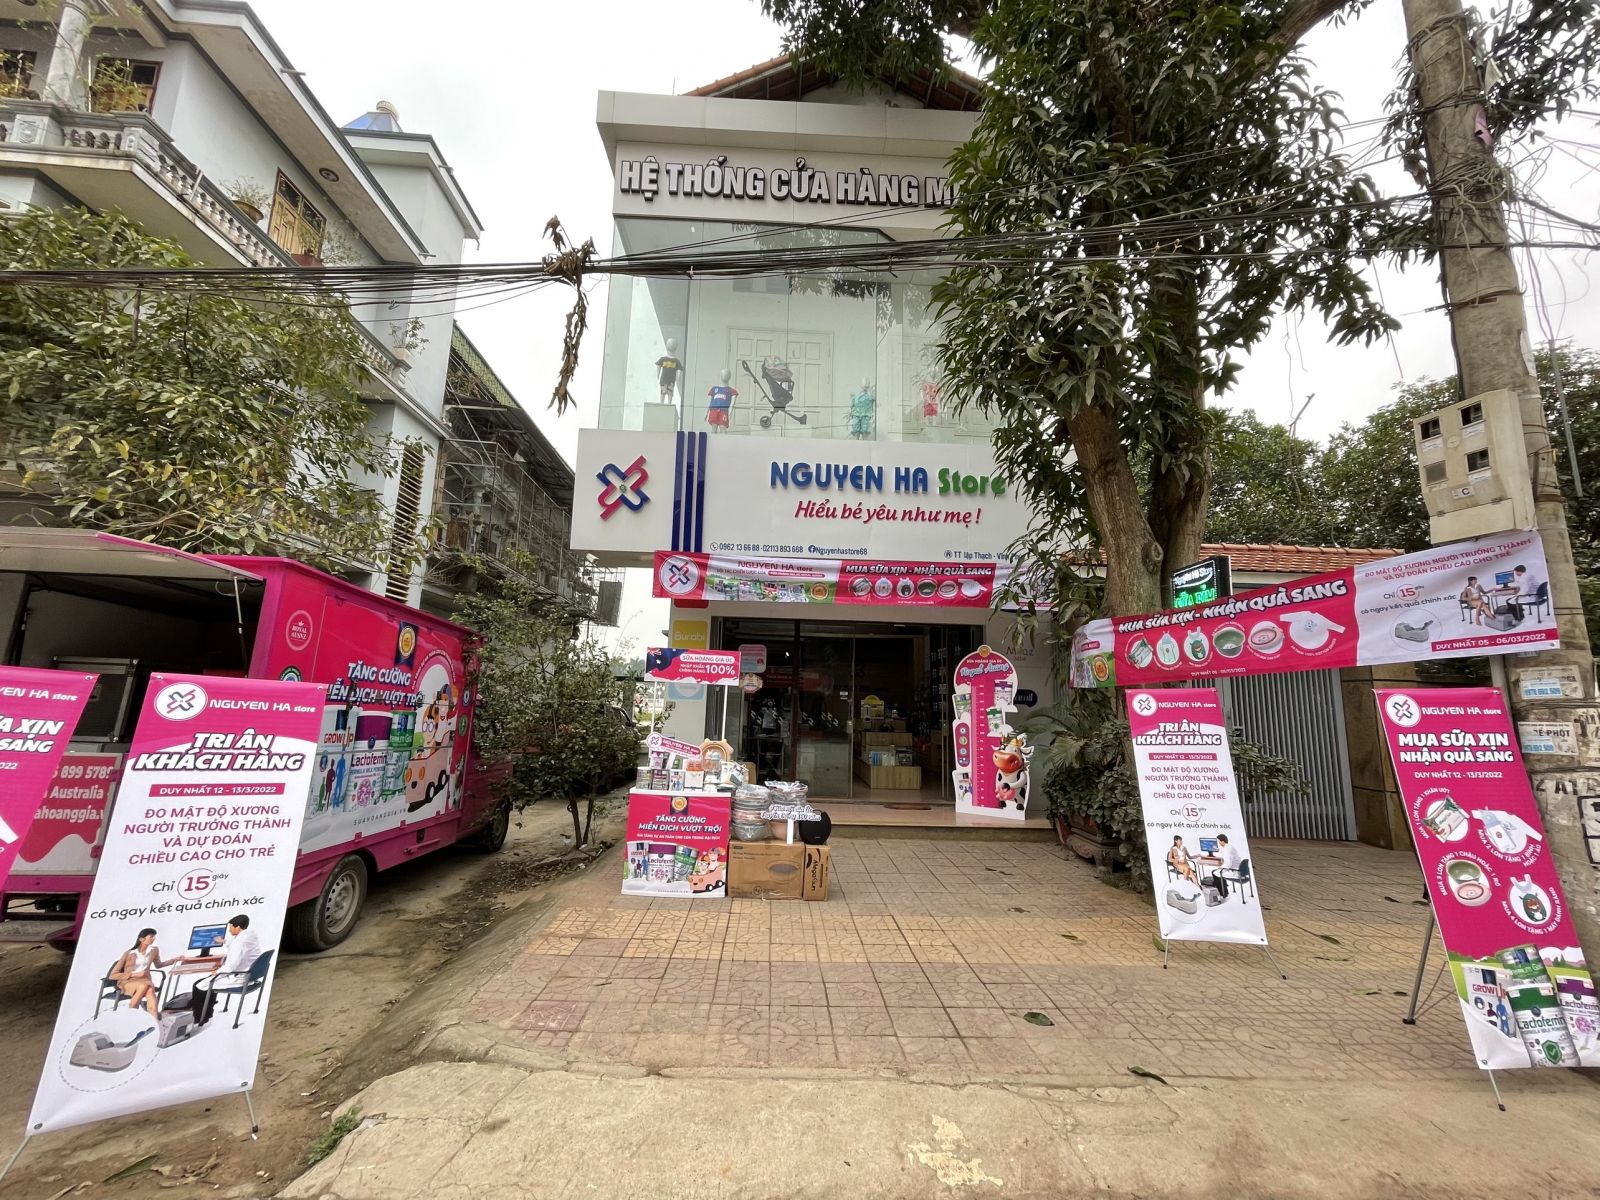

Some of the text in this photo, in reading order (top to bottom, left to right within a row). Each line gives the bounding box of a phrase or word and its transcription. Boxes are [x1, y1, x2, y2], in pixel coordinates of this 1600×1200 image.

[620, 155, 960, 208] HỆ THỐNG CỬA HÀNG M
[770, 461, 1006, 497] NGUYEN HA Store
[794, 499, 972, 528] Hiểu bé yêu như mẹ
[719, 542, 735, 551] 0962
[779, 545, 791, 553] 893
[845, 565, 868, 573] MUA
[869, 564, 889, 574] SỮA
[914, 566, 943, 578] NHẬN
[944, 564, 965, 576] QUÀ
[965, 567, 992, 575] SANG
[1399, 587, 1416, 597] 15
[1118, 621, 1145, 634] MUA
[1145, 614, 1170, 628] SỮA
[1203, 595, 1249, 618] NHẬN
[1249, 586, 1291, 611] QUÀ
[1291, 579, 1347, 603] SANG
[1453, 639, 1477, 649] NHẤT
[1496, 633, 1546, 645] 06/03/2022
[347, 660, 377, 680] TĂNG
[378, 665, 412, 686] CƯỜNG
[705, 664, 735, 675] 100%
[29, 689, 78, 701] HA store
[328, 677, 349, 701] IỄN
[209, 699, 270, 711] NGUYEN
[272, 703, 291, 712] HA
[1421, 706, 1465, 715] NGUYEN
[1467, 707, 1481, 715] HA
[1158, 719, 1200, 733] TRI ÂN
[0, 738, 54, 753] SANG
[193, 728, 275, 750] TRI ÂN
[1136, 732, 1222, 746] KHÁCH HÀNG
[1398, 732, 1439, 747] MUA
[1440, 728, 1478, 747] SỮA
[1478, 732, 1510, 751] XỊN
[134, 748, 305, 771] KHÁCH HÀNG
[1399, 747, 1514, 766] NHẬN QUÀ SANG
[61, 766, 83, 779] 899
[1193, 766, 1220, 774] XƯƠNG
[1414, 771, 1430, 779] DUY
[1431, 769, 1452, 779] NHẤT
[1467, 771, 1503, 779] 13/3/2022
[1202, 773, 1229, 782] THÀNH
[51, 785, 104, 800] Australia
[160, 786, 182, 795] DUY
[183, 784, 213, 795] NHẤT
[232, 785, 277, 795] 13/3/2022
[1189, 783, 1211, 791] ĐOÁN
[1194, 792, 1210, 800] CHO
[144, 804, 281, 819] ĐO MẬT ĐỘ XƯƠNG
[655, 813, 706, 824] TĂNG CƯỜNG
[1185, 807, 1199, 817] 15
[124, 815, 291, 835] NGƯỜI TRƯỞNG THÀNH
[638, 821, 722, 834] MIỄN DỊCH VƯỢT TRỘI
[162, 833, 252, 848] VÀ DỰ ĐOÁN
[128, 844, 276, 865] CHIỀU CAO CHO TRẺ
[151, 872, 230, 892] Chỉ 15 giây
[90, 896, 265, 920] có ngay kết quả chính xác
[1472, 983, 1496, 995] GROW
